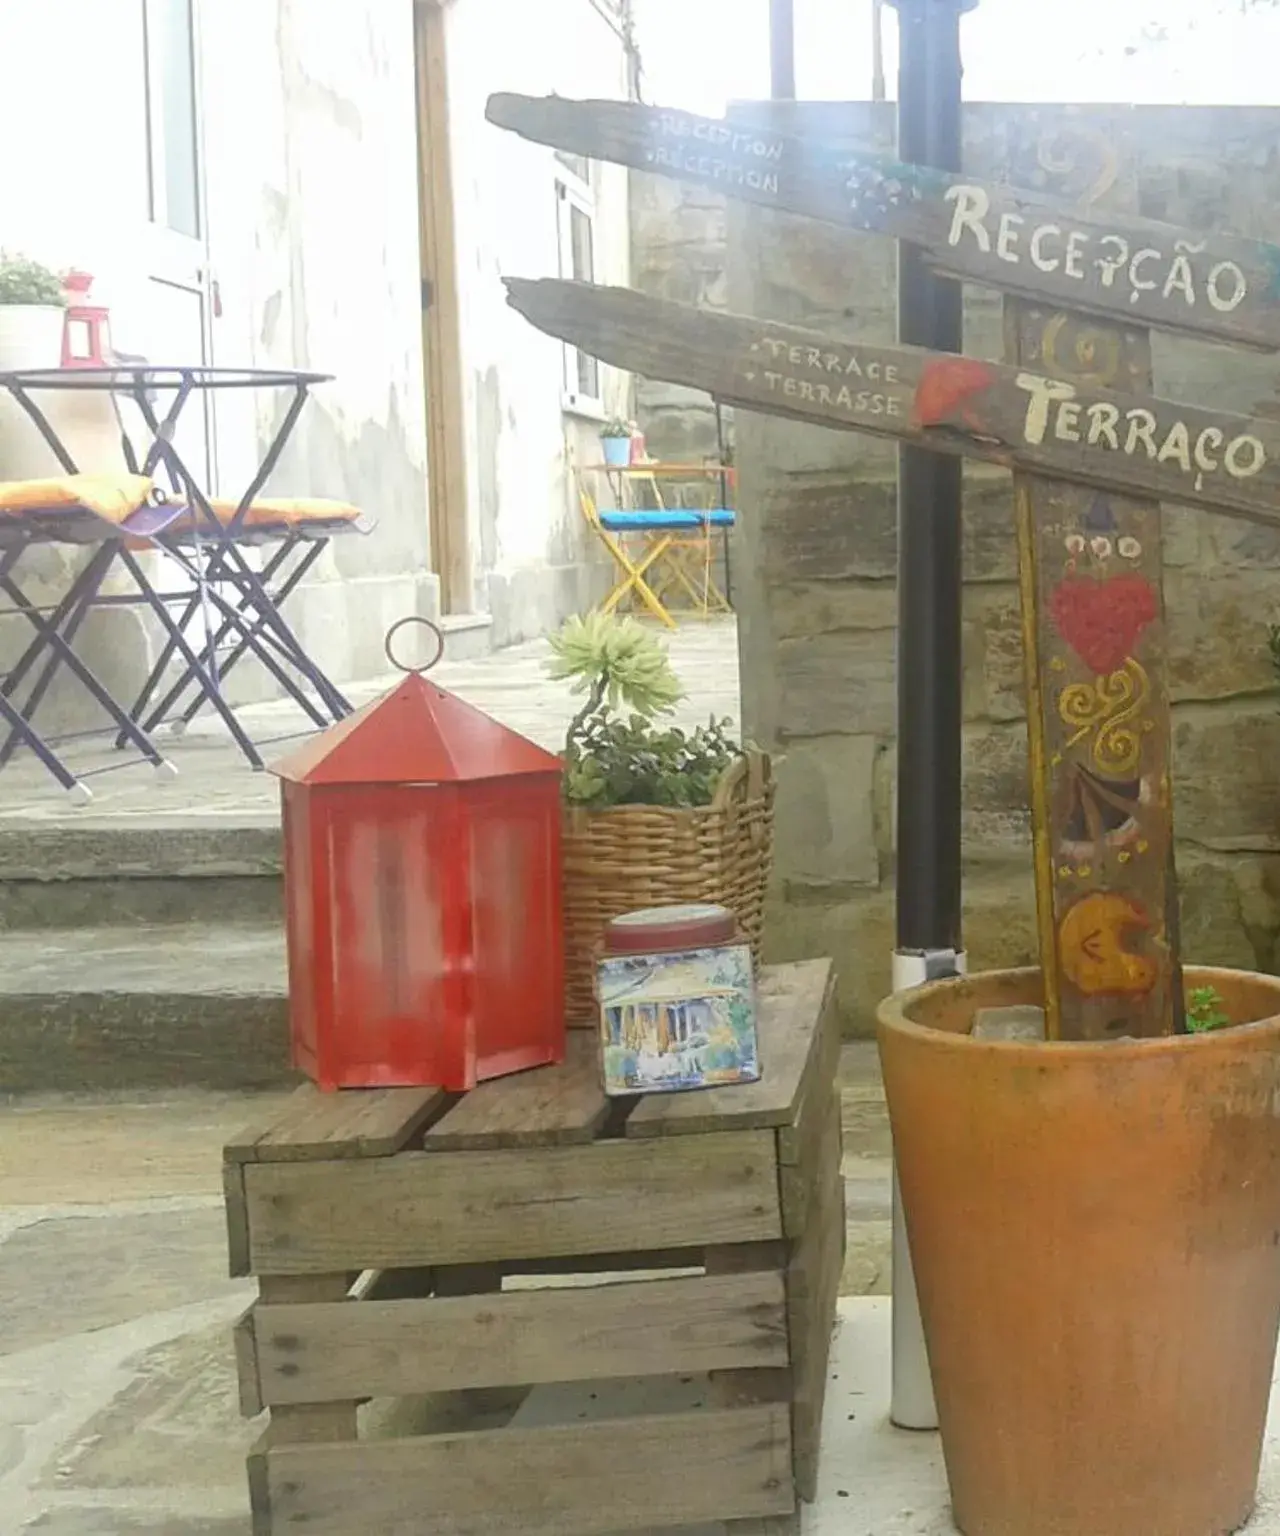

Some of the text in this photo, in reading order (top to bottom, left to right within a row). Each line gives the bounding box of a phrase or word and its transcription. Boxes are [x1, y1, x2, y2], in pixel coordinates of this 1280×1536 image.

[944, 185, 1247, 312] RECEPÇÃO
[763, 338, 899, 383] TERRACE
[764, 371, 899, 417] TERRASSE
[1015, 372, 1266, 491] TERRAÇO
